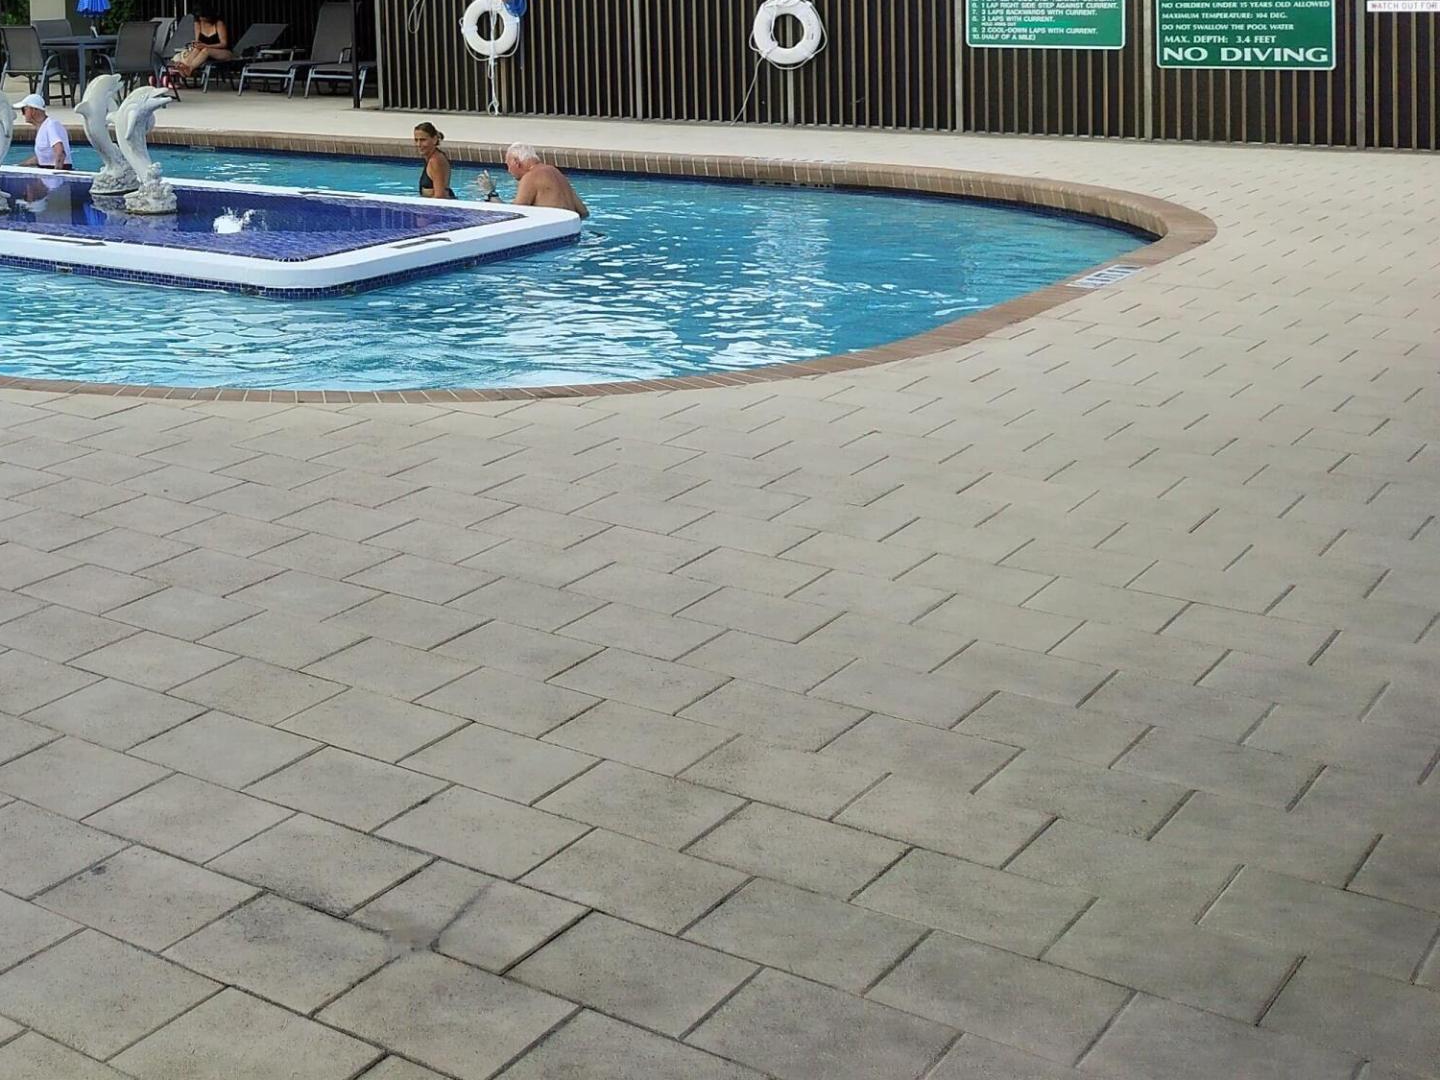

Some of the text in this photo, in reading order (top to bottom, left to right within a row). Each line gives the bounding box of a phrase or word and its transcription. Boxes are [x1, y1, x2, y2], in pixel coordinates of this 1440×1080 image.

[1163, 35, 1276, 43] MAX. DEPTH: 3.4 FEET
[1163, 46, 1328, 62] NO DIVING
